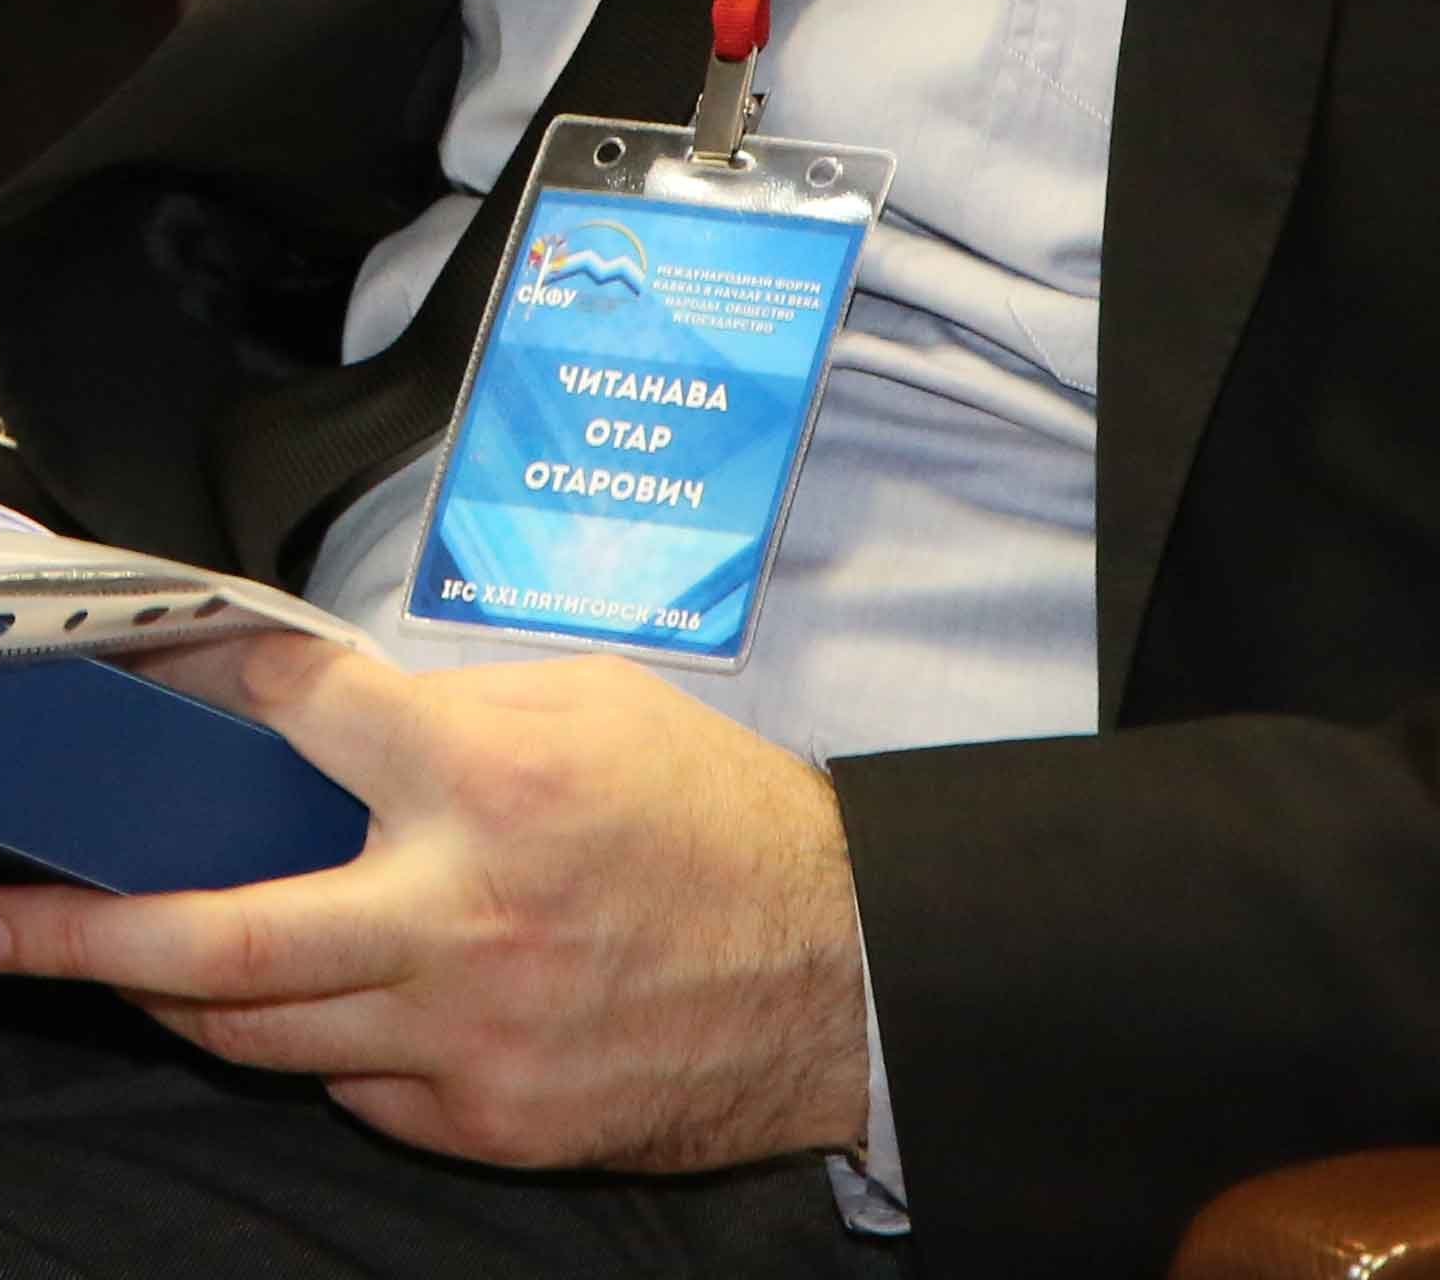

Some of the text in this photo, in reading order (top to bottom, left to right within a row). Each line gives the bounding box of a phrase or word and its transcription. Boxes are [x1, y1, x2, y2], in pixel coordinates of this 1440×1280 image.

[559, 364, 728, 411] ЧИТАНАВА
[585, 418, 672, 453] ОТАР
[524, 460, 704, 509] ОТАРОВИЧ
[441, 579, 702, 632] IFC XXI ПЯТИГОРСК 2016
